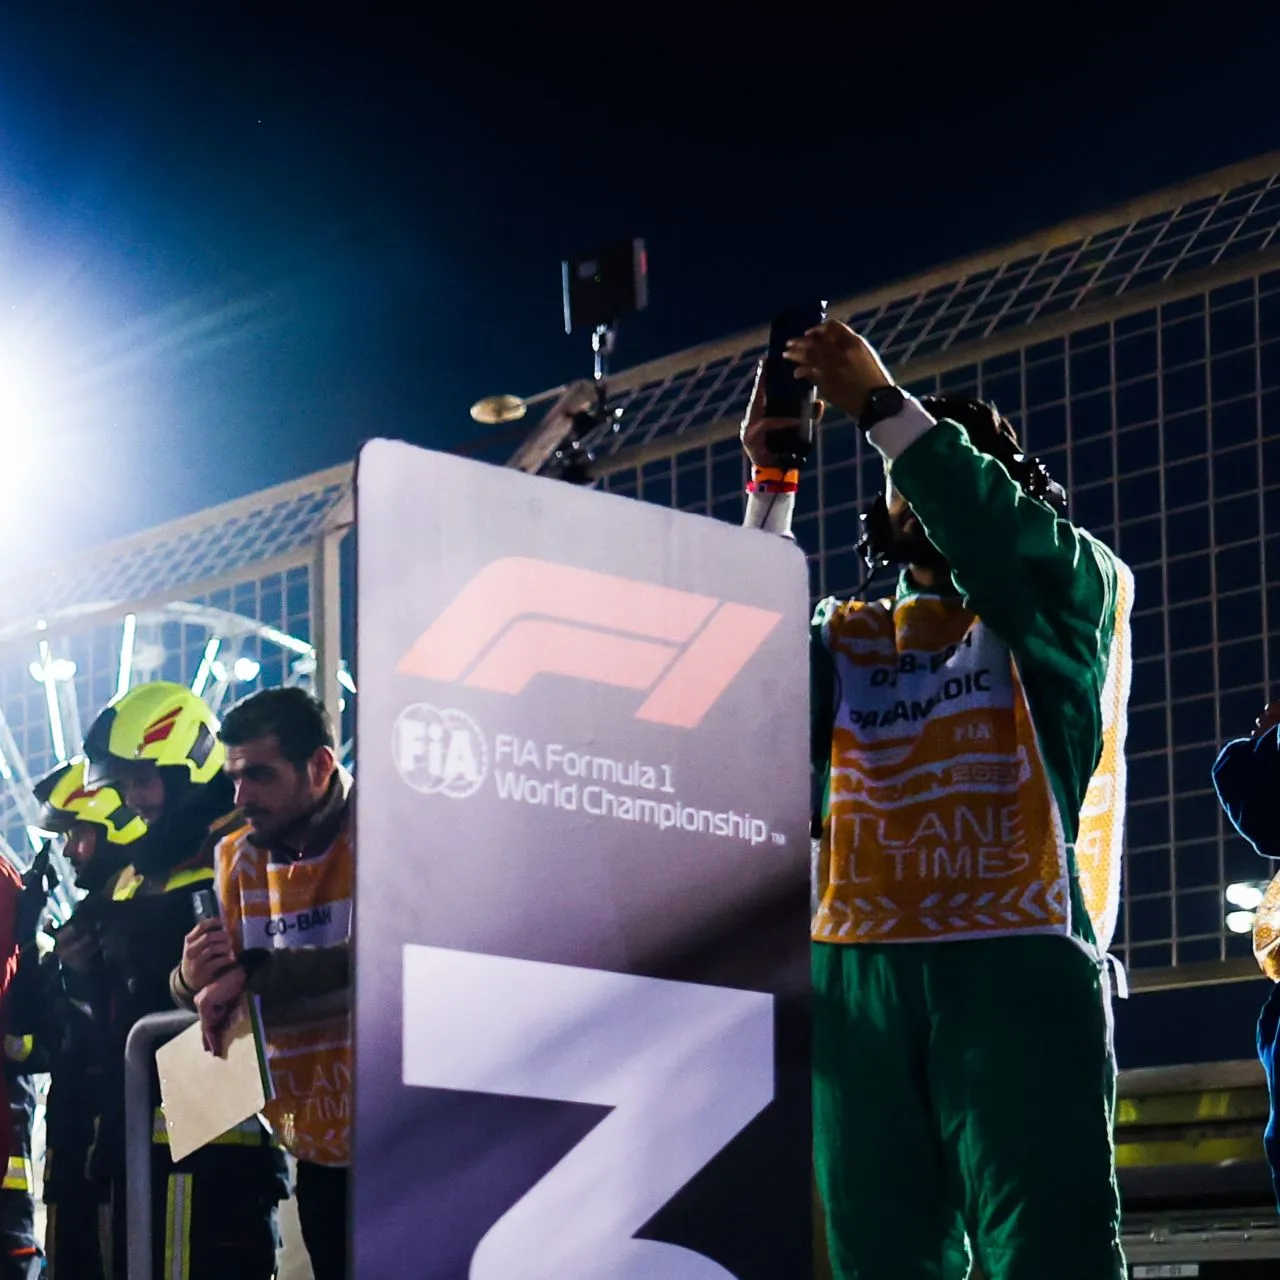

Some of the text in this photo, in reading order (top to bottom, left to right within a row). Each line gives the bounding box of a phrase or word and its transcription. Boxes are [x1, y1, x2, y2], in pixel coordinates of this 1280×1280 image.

[398, 718, 478, 783] FIA
[495, 734, 676, 793] FIA Formula 1
[494, 769, 578, 812] World
[582, 784, 769, 846] Championship
[884, 840, 1030, 883] TIMES
